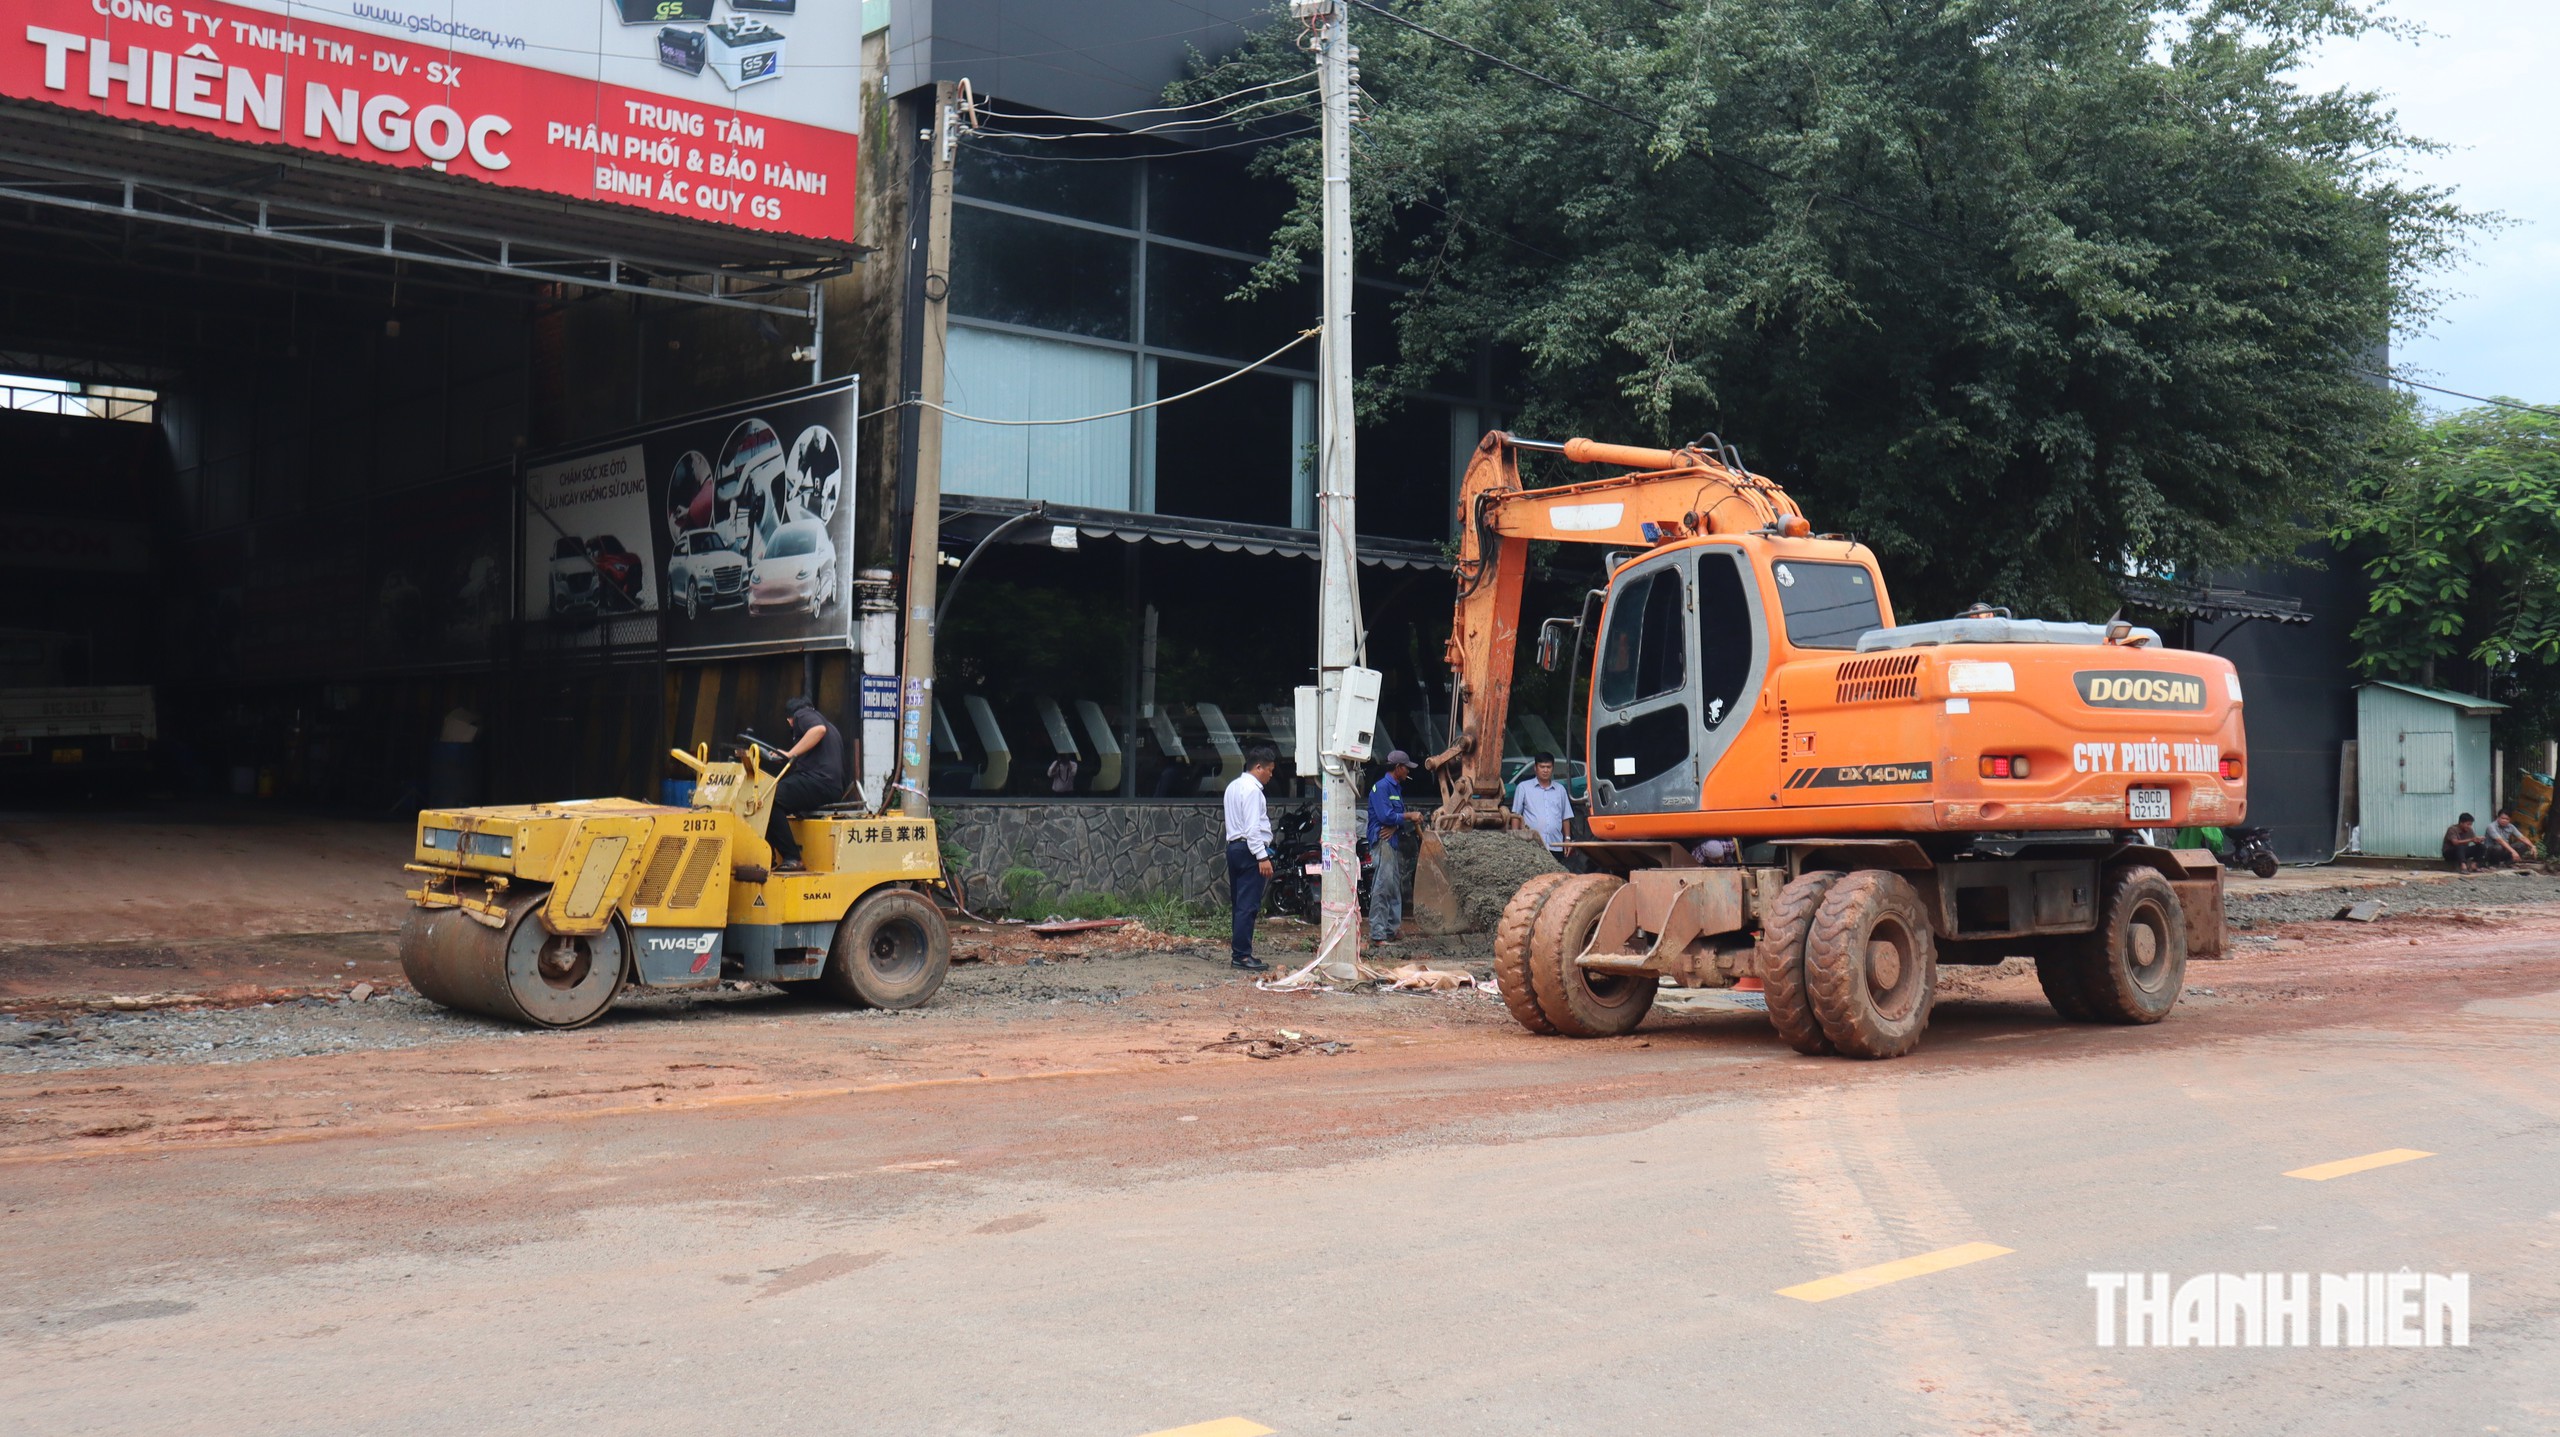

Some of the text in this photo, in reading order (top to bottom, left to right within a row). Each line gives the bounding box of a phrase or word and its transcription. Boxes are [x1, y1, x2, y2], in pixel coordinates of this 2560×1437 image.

[656, 1, 684, 15] GS
[353, 2, 525, 51] www.gsbattery.vn
[182, 10, 224, 38] TY
[230, 20, 306, 57] TNHH
[312, 37, 354, 66] TM
[372, 50, 409, 76] DV
[426, 61, 462, 88] SX
[743, 55, 763, 71] GS
[26, 25, 513, 172] THIÊN NGỌC
[624, 100, 765, 150] TRUNG TÂM
[547, 120, 827, 196] PHÂN PHỐI & BẢO HÀNH
[595, 162, 782, 221] BÌNH ẮC QUY GS
[582, 463, 598, 482] SÓC
[599, 463, 609, 478] XE
[864, 689, 881, 707] THIÊN
[881, 692, 897, 711] NGỌC
[2089, 678, 2199, 705] DOOSAN
[2073, 736, 2219, 773] CTY PHÚC THÀNH
[706, 773, 736, 786] SAKAI
[2138, 791, 2162, 804] 60CD
[2134, 805, 2167, 819] 021.31
[683, 819, 716, 832] 21873
[803, 892, 831, 901] SAKAI
[648, 937, 709, 951] TW450
